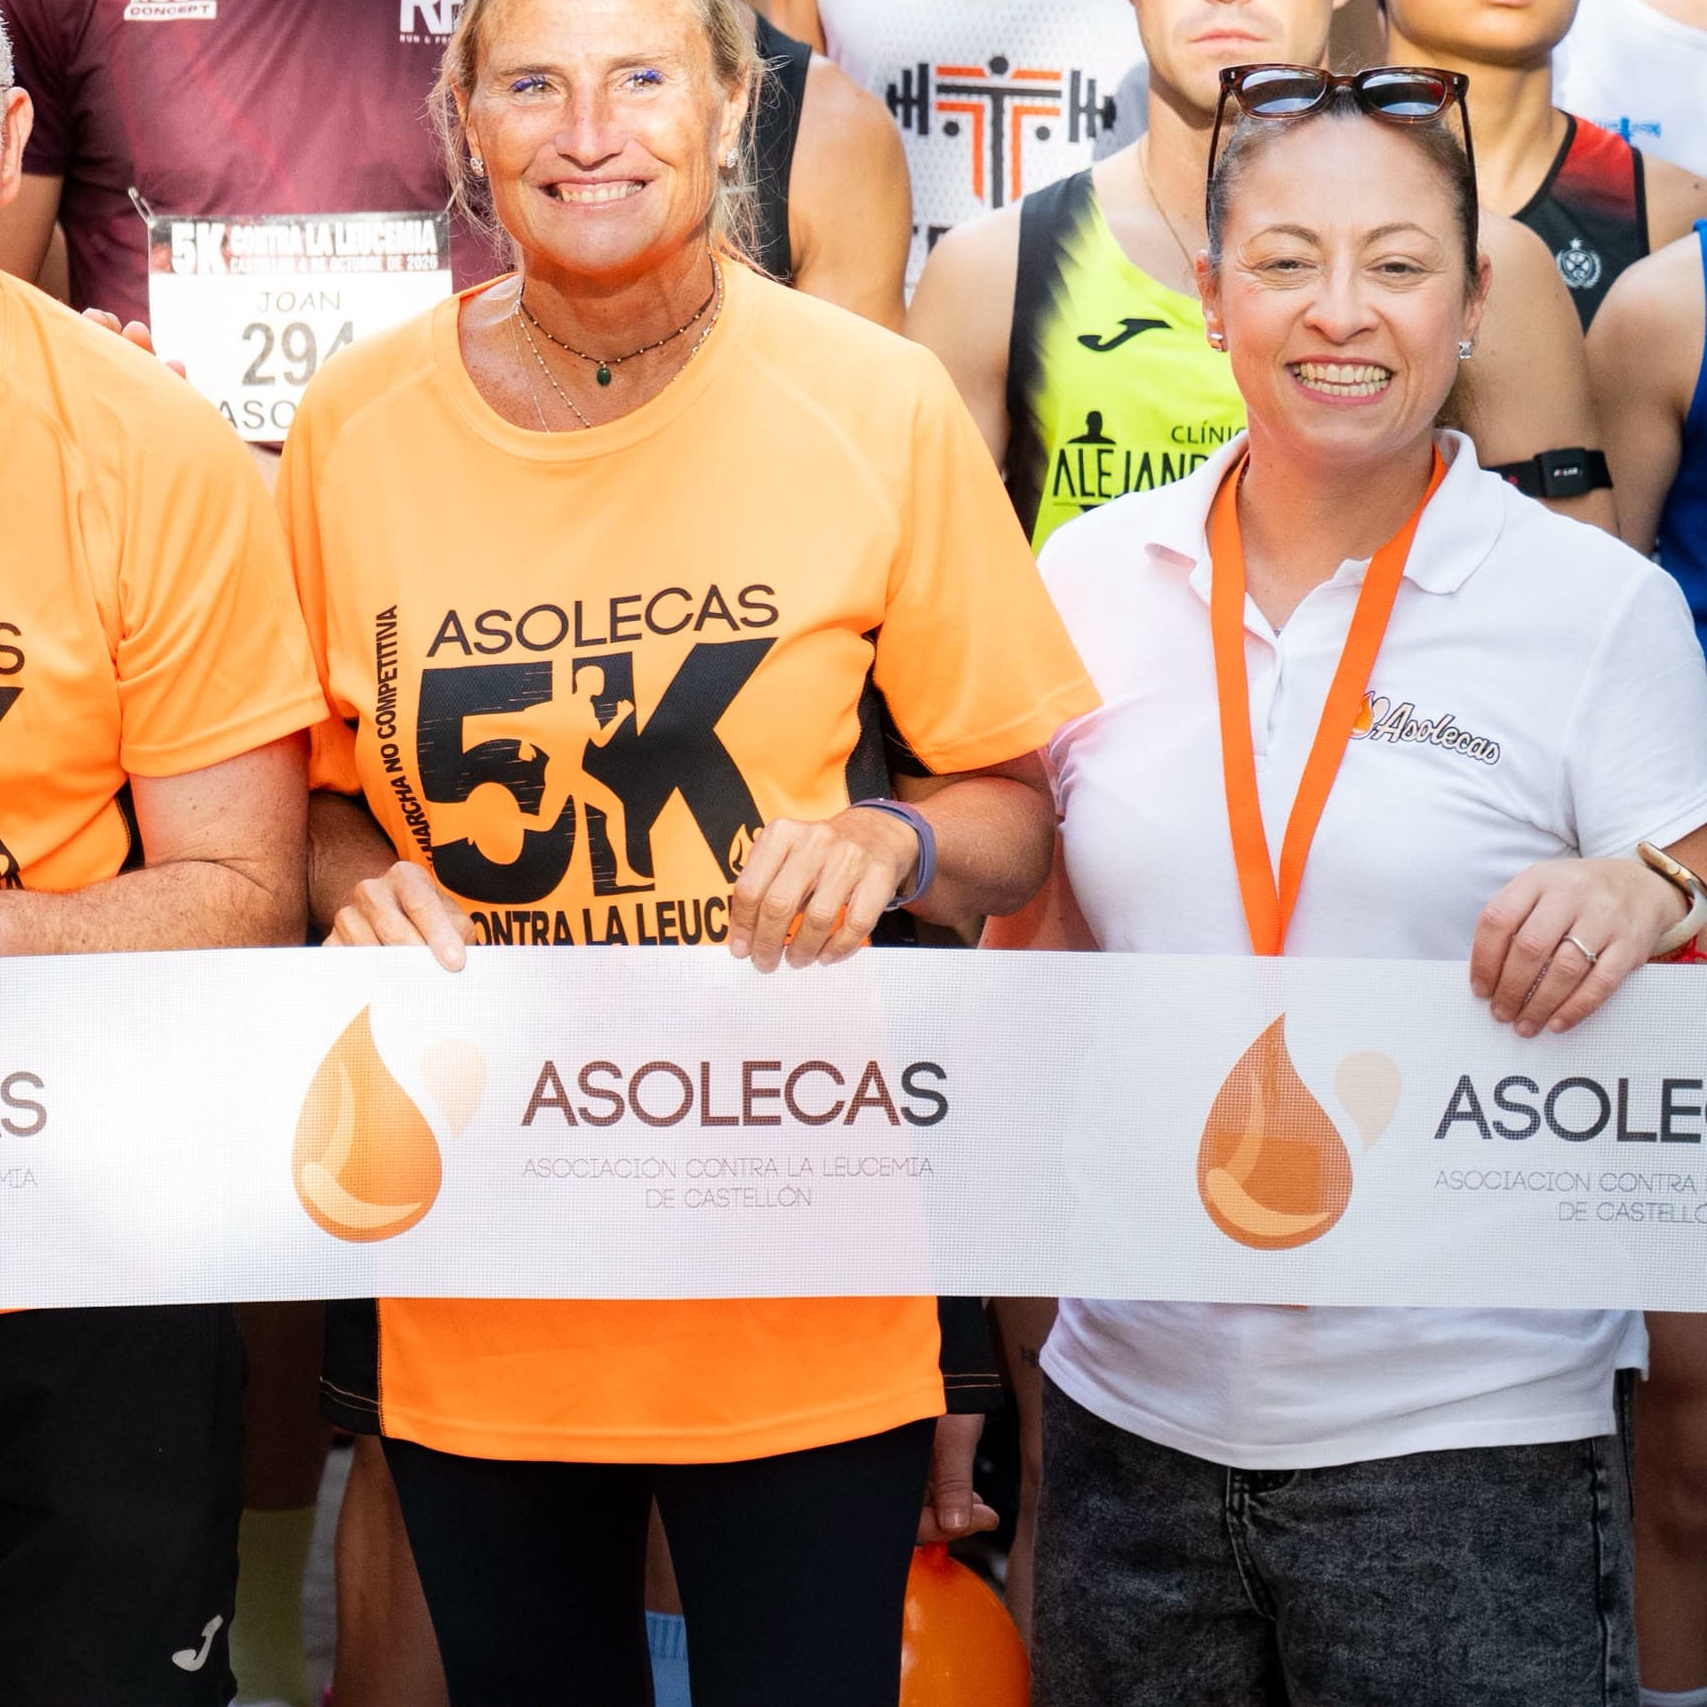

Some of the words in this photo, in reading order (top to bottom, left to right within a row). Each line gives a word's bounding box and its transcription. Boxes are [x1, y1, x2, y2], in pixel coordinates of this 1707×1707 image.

[130, 4, 210, 16] CONCEPT
[171, 221, 230, 274] 5K
[230, 224, 303, 255] CONTRA
[306, 222, 334, 255] LA
[336, 219, 438, 255] LEUCEMIA
[257, 290, 342, 313] JOAN
[425, 583, 780, 658] ASOLECAS
[375, 604, 398, 739] COMPETITIVA
[379, 742, 403, 773] NO
[1370, 702, 1501, 765] Asolecas
[415, 636, 779, 905] 5K
[389, 776, 431, 861] MARCHA
[473, 909, 574, 946] ONTRA
[581, 905, 624, 946] LA
[520, 1060, 949, 1127] ASOLECAS
[1434, 1075, 1707, 1144] ASOLE
[521, 1156, 677, 1179] ASOCIACIÓN
[686, 1157, 780, 1178] CONTRA
[787, 1157, 814, 1177] LA
[822, 1156, 935, 1178] LEUCEMIA
[1598, 1171, 1699, 1195] CONTRA
[645, 1188, 675, 1209] DE
[1558, 1200, 1588, 1222] DE
